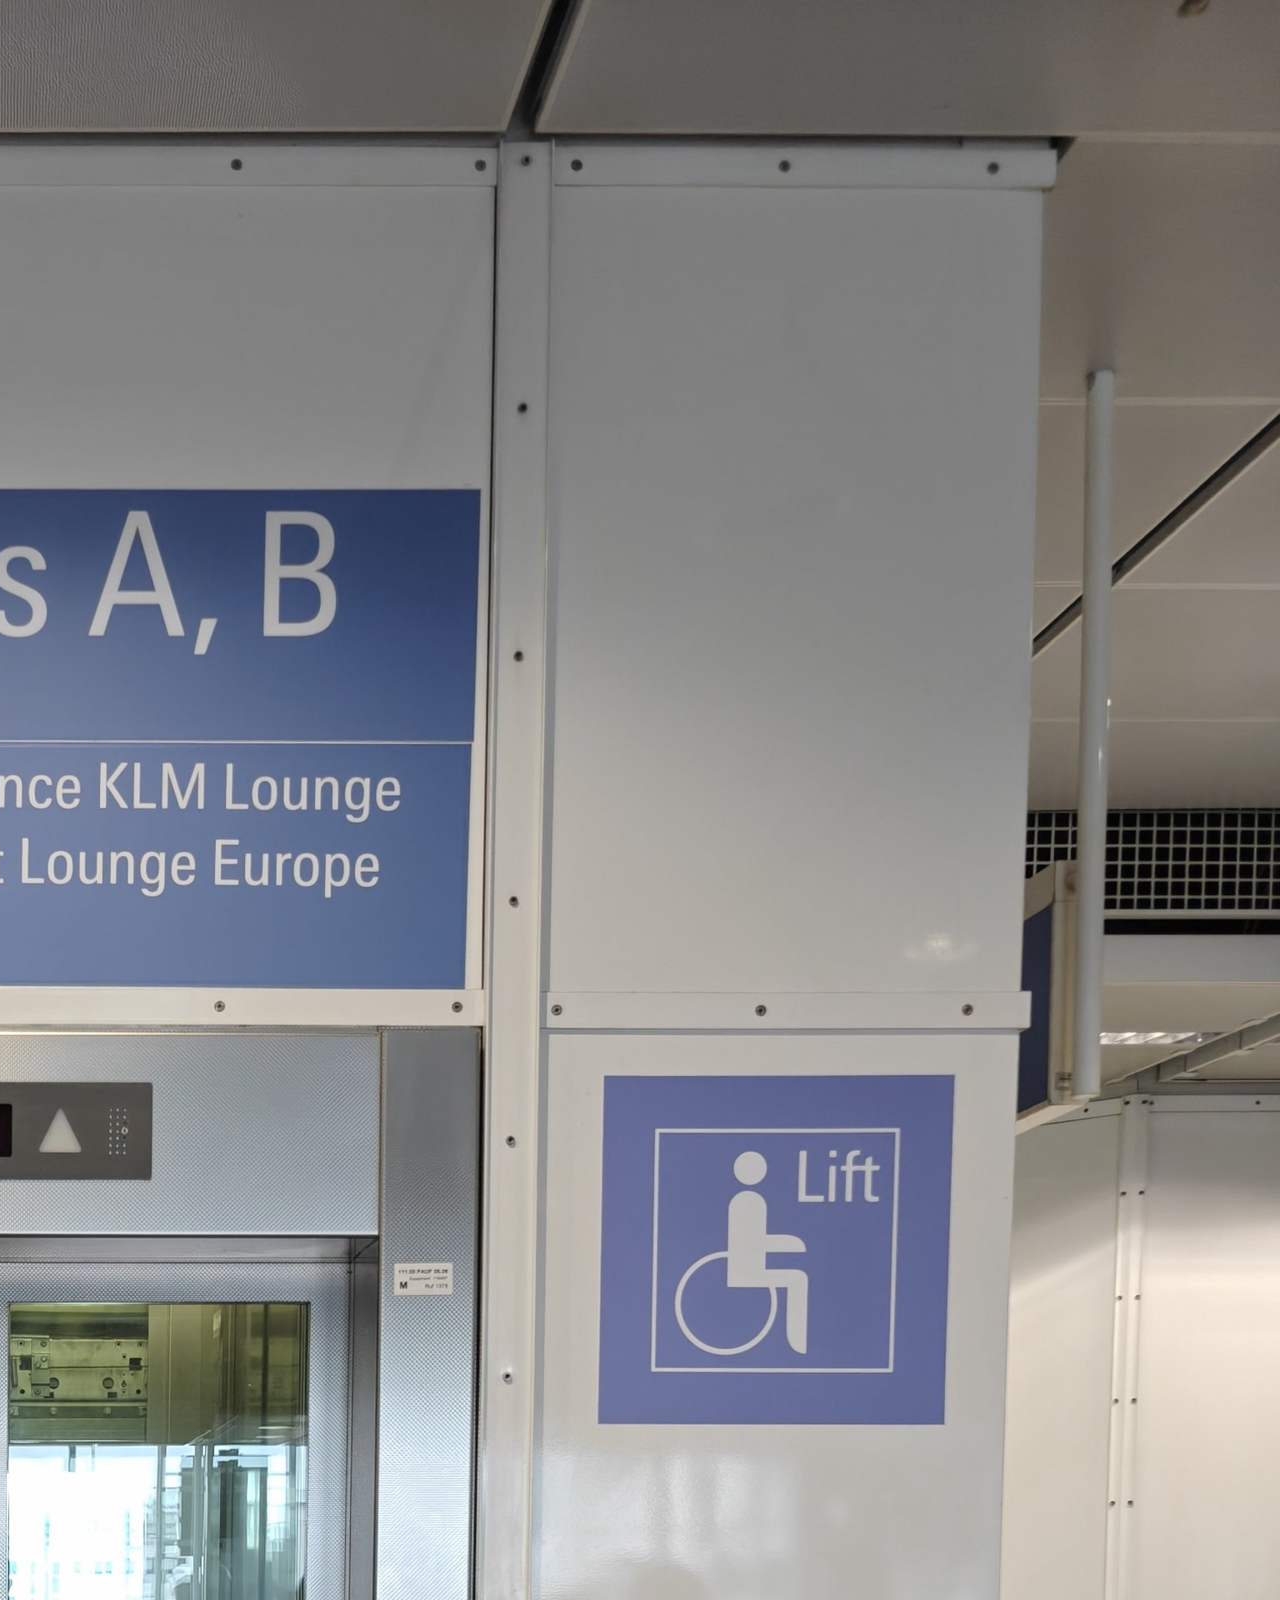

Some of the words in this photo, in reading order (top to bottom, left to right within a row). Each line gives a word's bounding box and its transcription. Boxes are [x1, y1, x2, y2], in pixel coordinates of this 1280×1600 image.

[88, 510, 218, 656] A,
[263, 511, 338, 637] B
[99, 761, 206, 811] KLM
[225, 762, 402, 824] Lounge
[20, 837, 197, 898] Lounge
[214, 838, 381, 899] Europe
[797, 1150, 881, 1203] Lift
